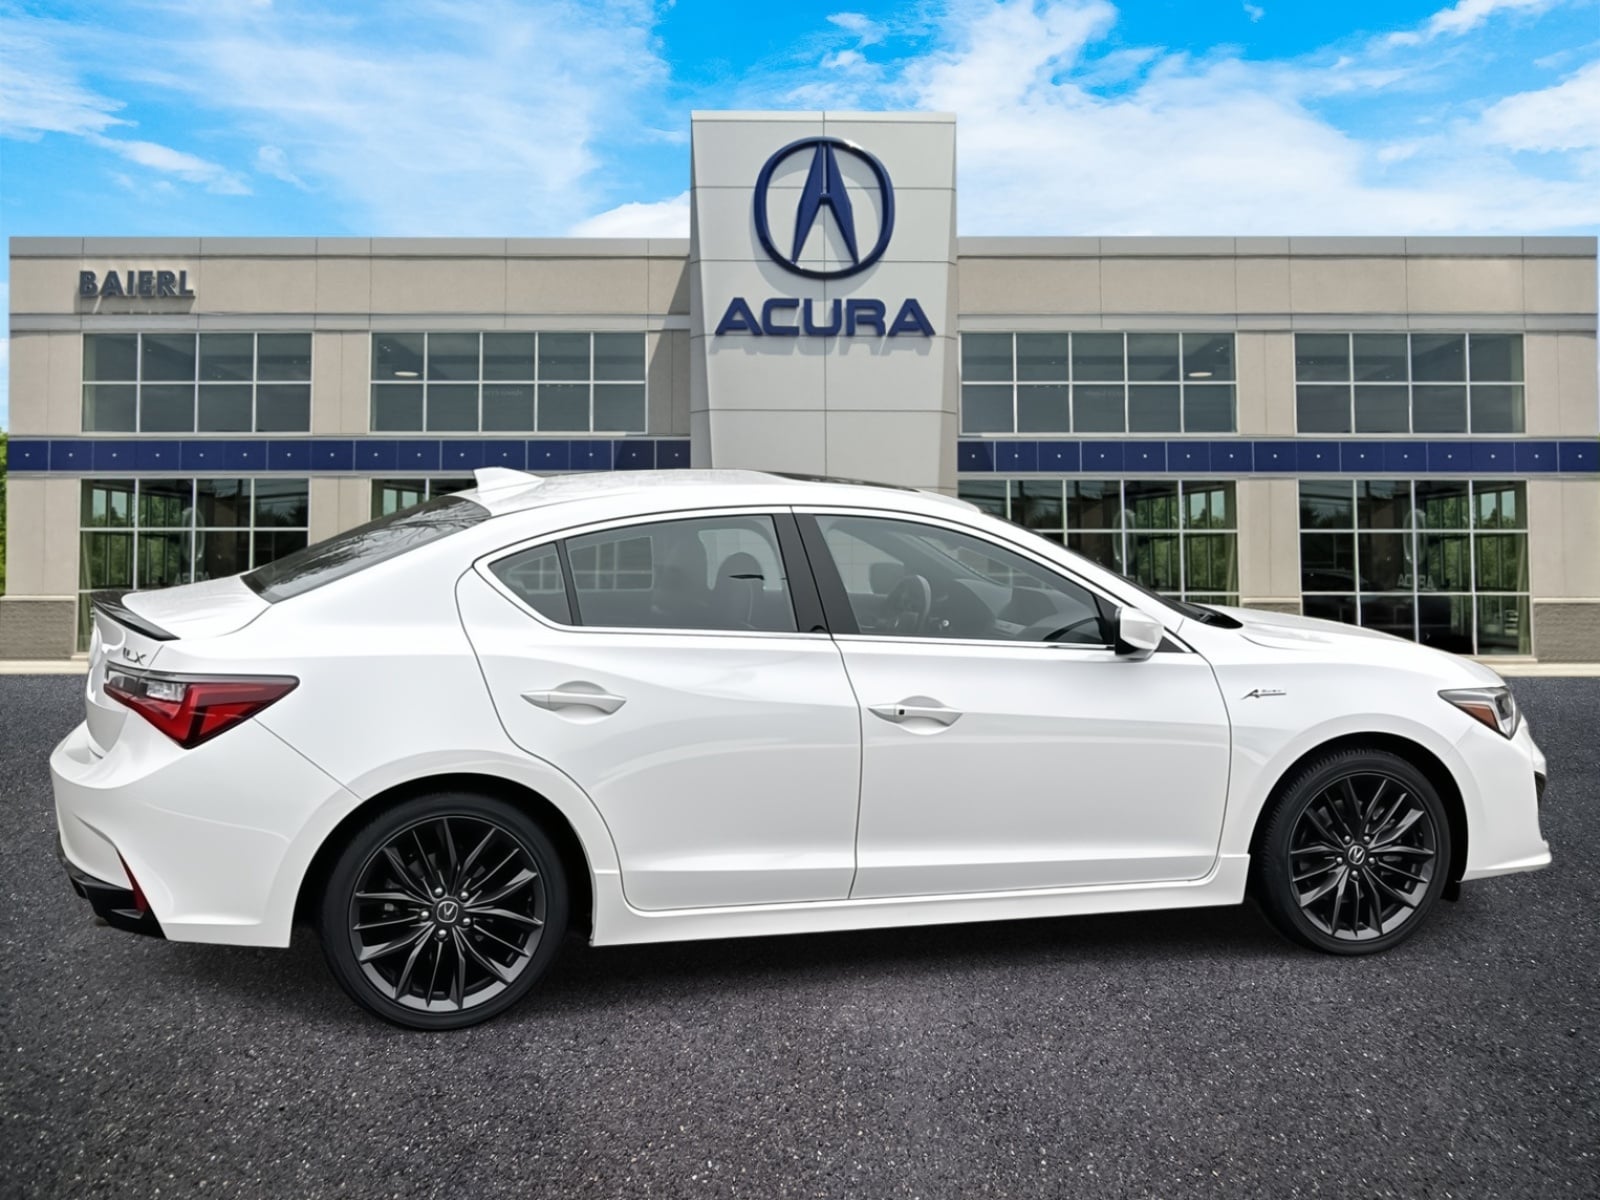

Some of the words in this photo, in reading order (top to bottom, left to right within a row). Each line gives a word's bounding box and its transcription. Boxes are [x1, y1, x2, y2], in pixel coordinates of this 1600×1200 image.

[79, 270, 195, 298] BAIERL
[714, 297, 937, 337] ACURA
[1396, 573, 1434, 589] ACRA
